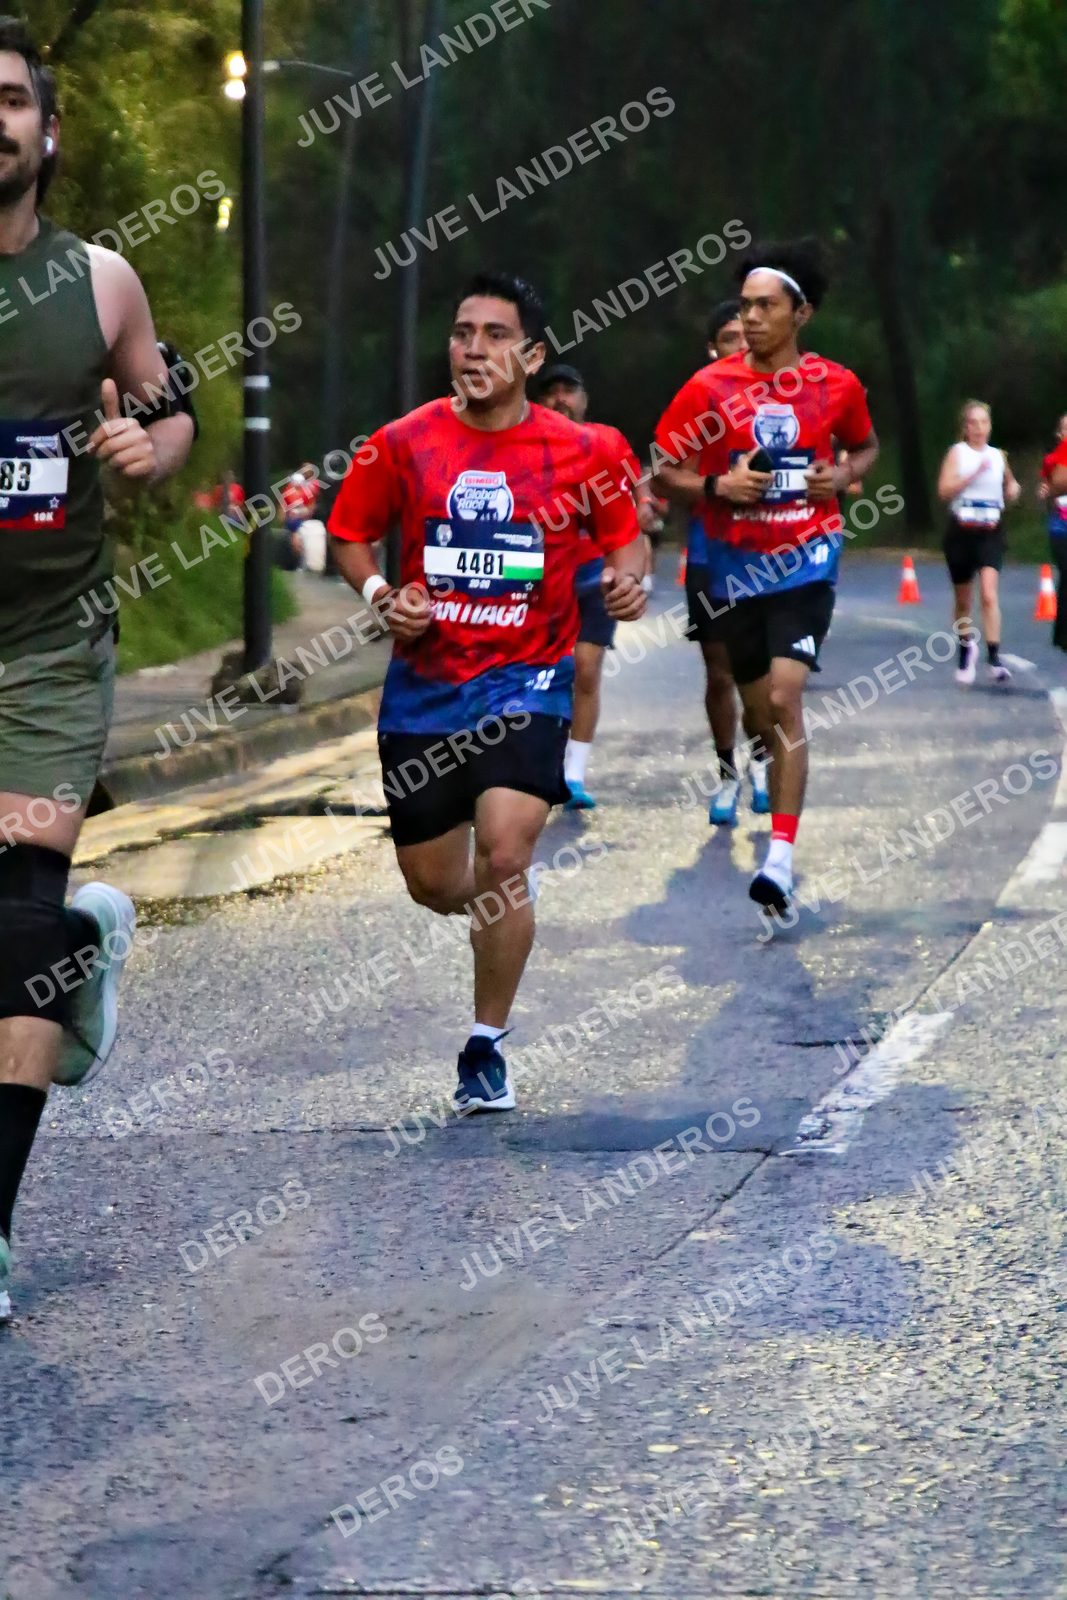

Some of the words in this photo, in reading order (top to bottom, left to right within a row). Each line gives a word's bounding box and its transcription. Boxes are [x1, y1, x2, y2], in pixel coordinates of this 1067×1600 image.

[464, 488, 498, 500] Global
[456, 551, 504, 576] 4481
[430, 600, 529, 628] ANTIAGO
